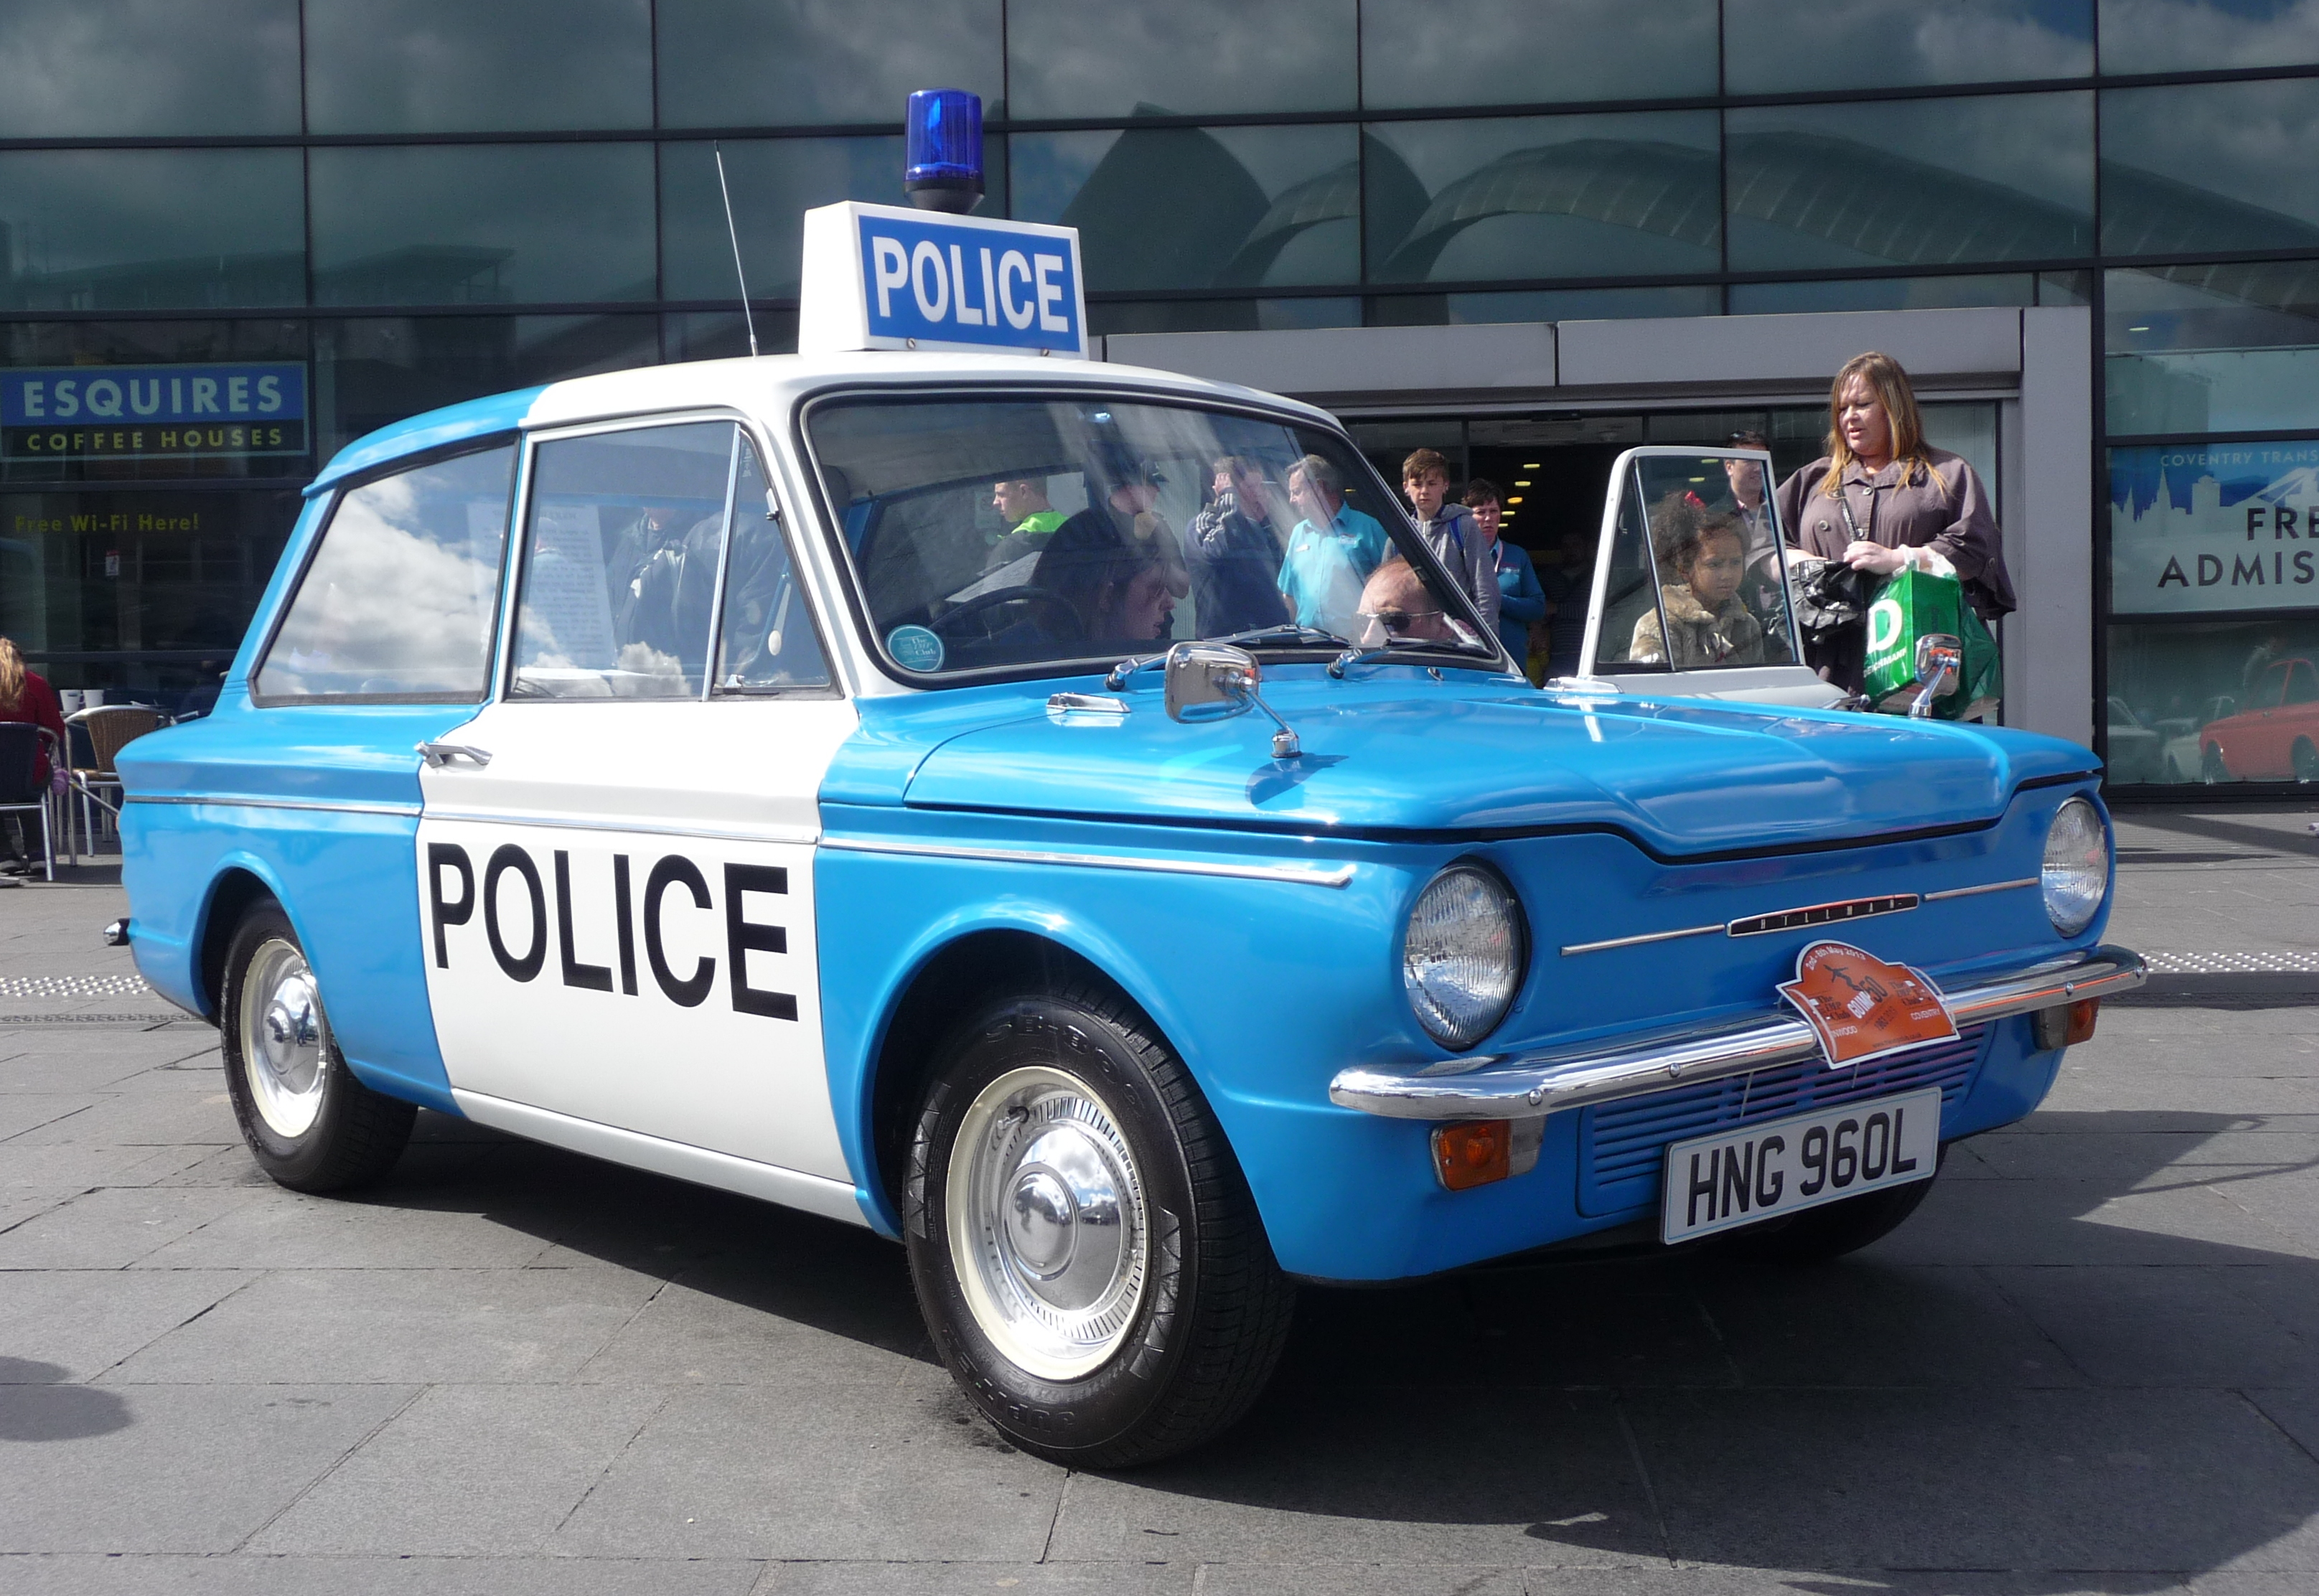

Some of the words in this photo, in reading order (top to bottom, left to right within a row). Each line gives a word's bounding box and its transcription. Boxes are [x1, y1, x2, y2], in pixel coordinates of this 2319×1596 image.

[873, 236, 1068, 333] POLICE
[24, 375, 282, 417] ESQUIRES
[27, 431, 144, 451] COFFEE
[160, 428, 282, 448] HOUSES
[2160, 451, 2252, 466] COVENTRY
[2261, 449, 2319, 464] TRANS
[14, 515, 62, 532] Free
[70, 514, 128, 532] Wi-Fi
[138, 512, 200, 531] Here!
[2158, 550, 2315, 588] ADMIS
[1868, 598, 1903, 654] D
[1760, 898, 1896, 930] HILLMAN
[428, 842, 798, 1023] POLICE
[1826, 946, 1845, 956] May
[1910, 1008, 1941, 1020] COVENTRY
[1687, 1135, 1785, 1226] HNG
[1800, 1108, 1917, 1196] 960L
